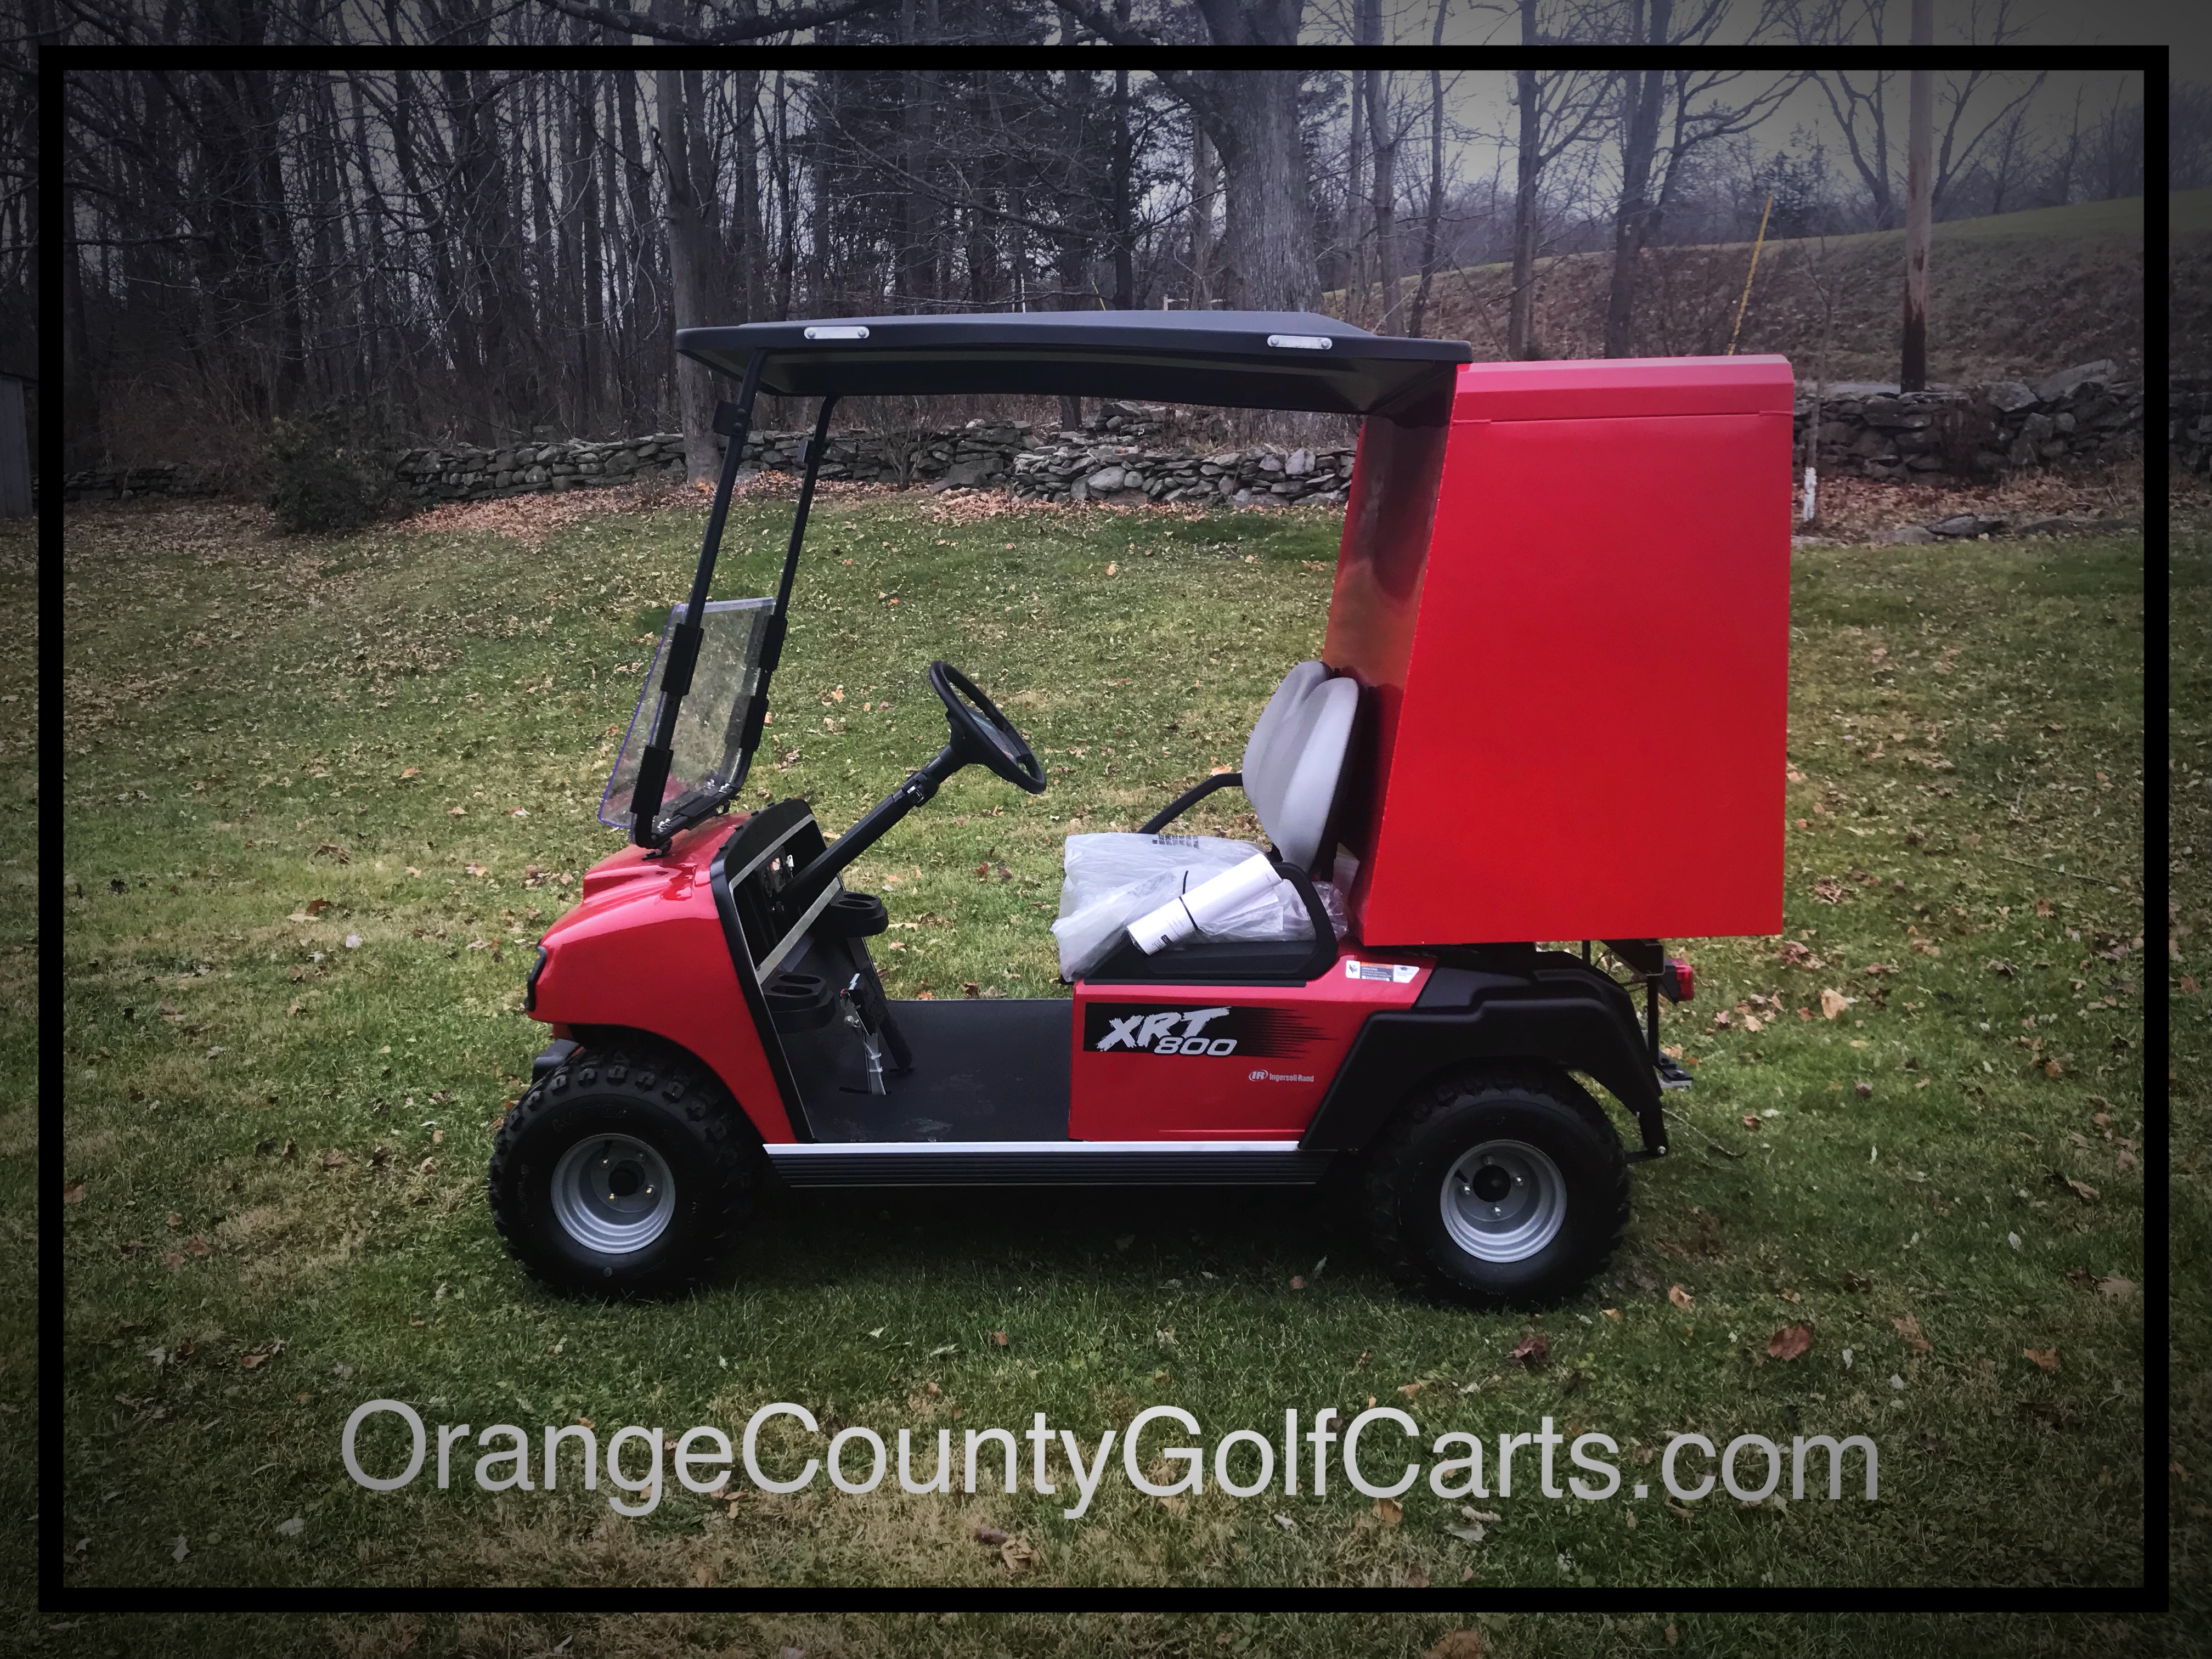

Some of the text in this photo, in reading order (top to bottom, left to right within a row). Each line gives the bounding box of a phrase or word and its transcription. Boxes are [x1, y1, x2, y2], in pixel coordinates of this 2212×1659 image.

[1096, 1007, 1232, 1051] XRT
[1154, 1037, 1237, 1056] 800
[1251, 1071, 1265, 1080] IR
